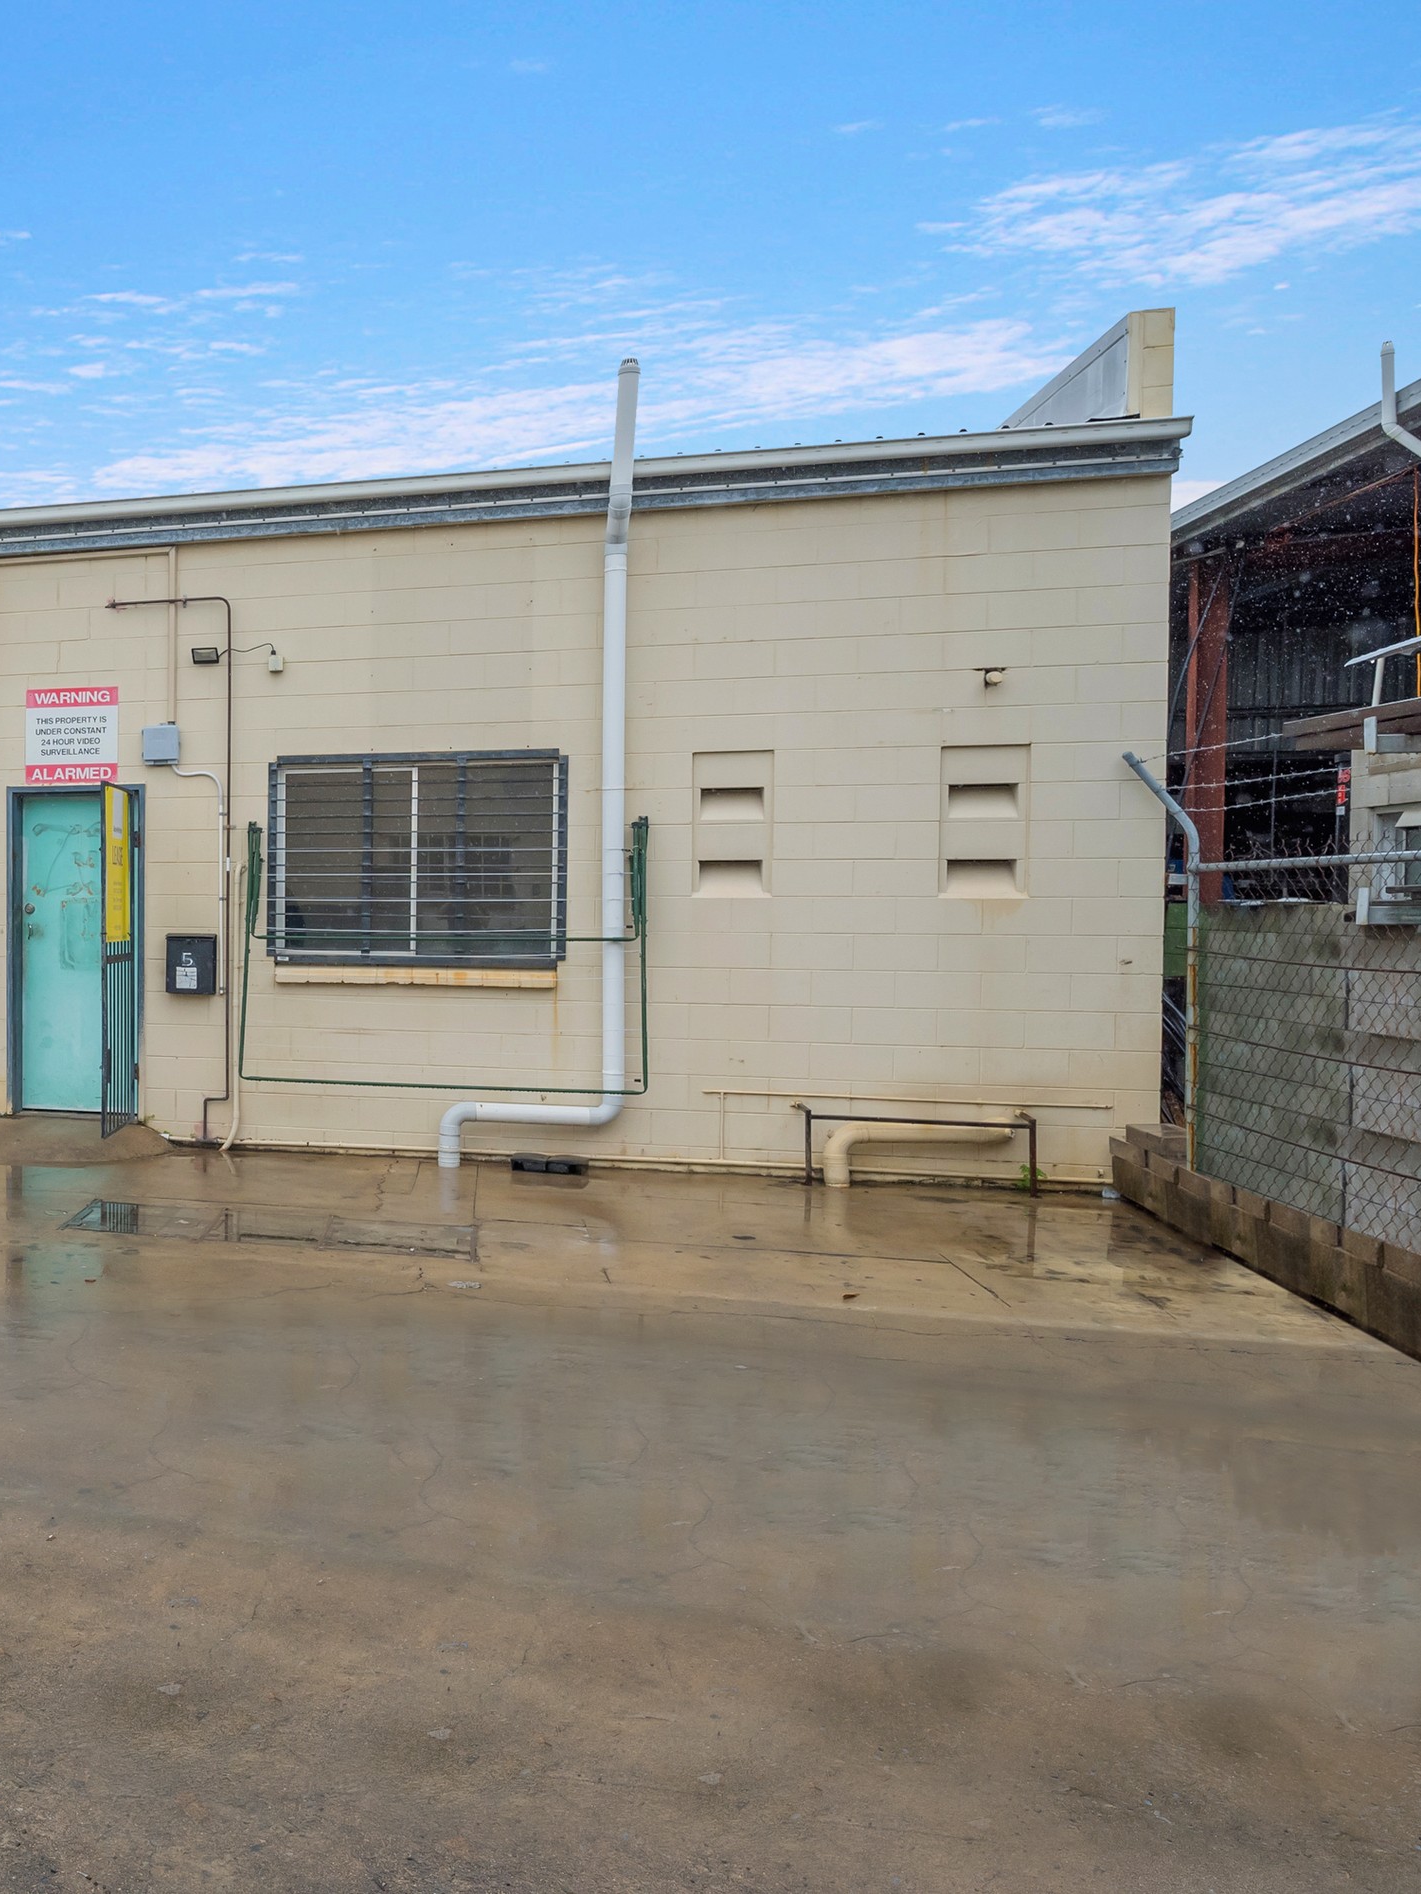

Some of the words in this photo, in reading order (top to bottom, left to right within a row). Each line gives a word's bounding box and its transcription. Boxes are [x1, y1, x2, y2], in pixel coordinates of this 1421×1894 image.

[34, 690, 111, 705] WARNING
[36, 717, 54, 725] THIS
[55, 716, 98, 725] PROPERTY
[99, 715, 107, 723] IS
[35, 728, 62, 736] UNDER
[63, 726, 107, 735] CONSTANT
[52, 738, 75, 746] HOUR
[77, 737, 101, 745] VIDEO
[40, 747, 101, 756] SURVEILLANCE
[31, 766, 112, 781] ALARMED
[181, 952, 194, 967] 5
